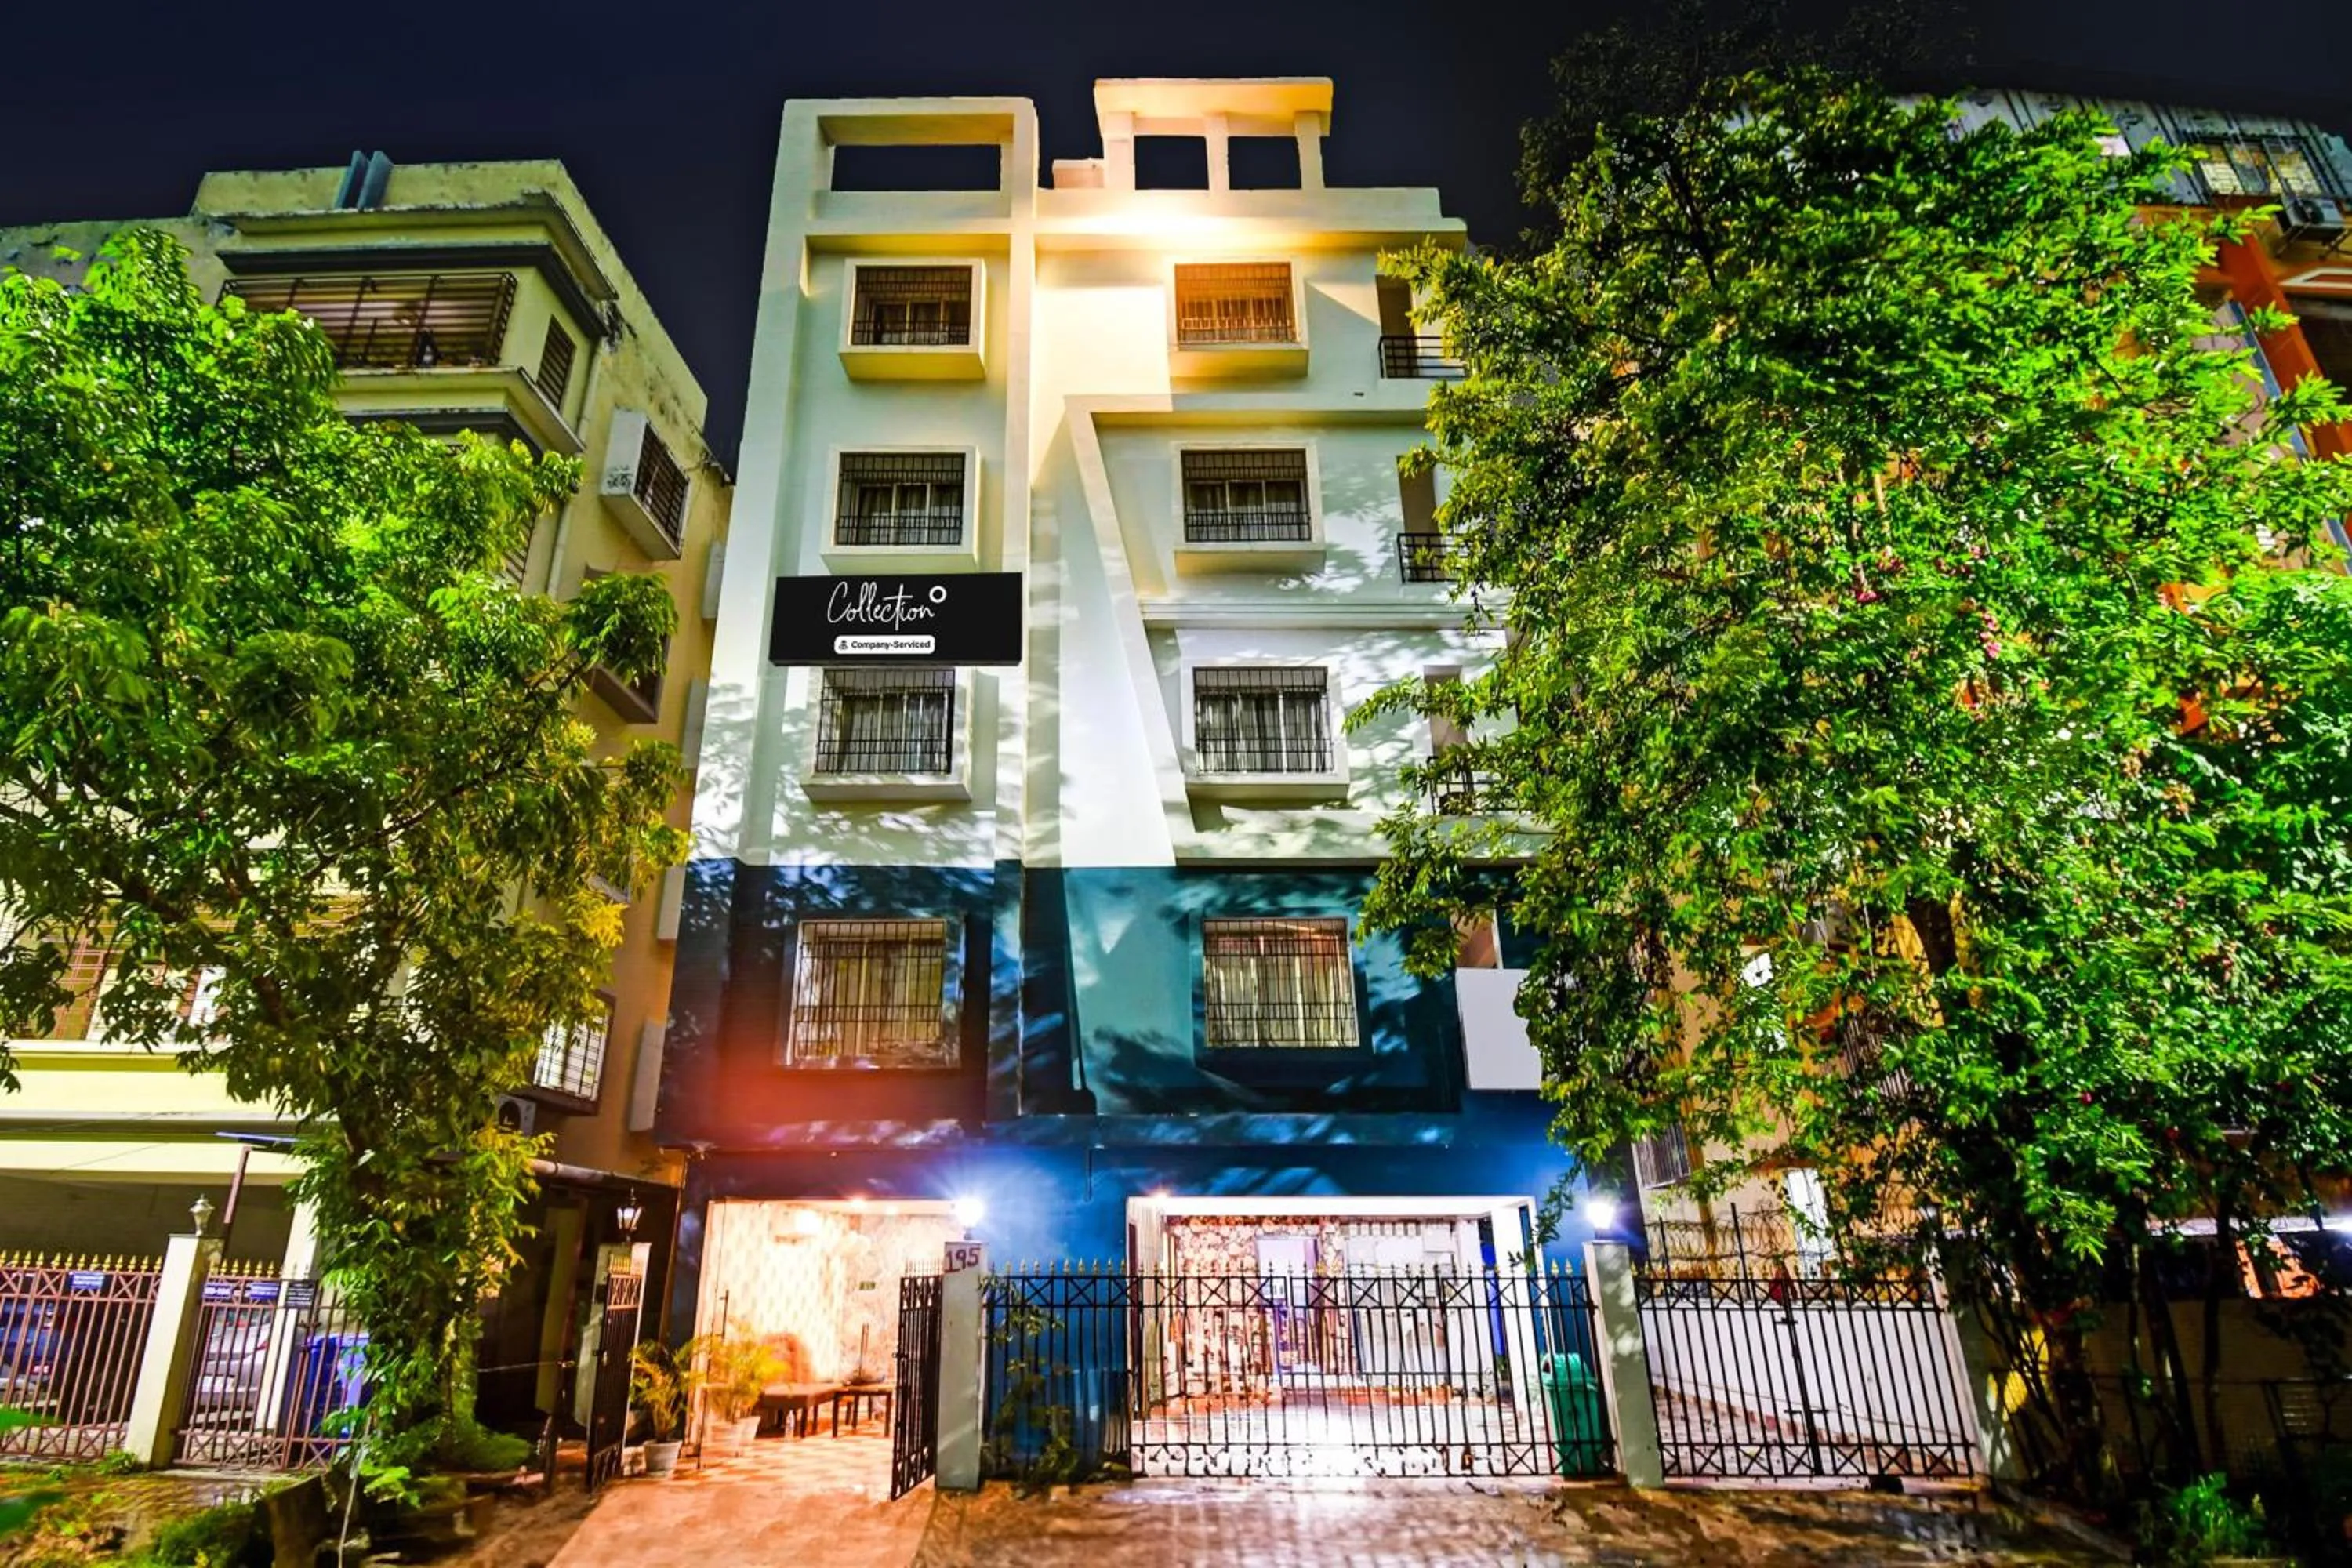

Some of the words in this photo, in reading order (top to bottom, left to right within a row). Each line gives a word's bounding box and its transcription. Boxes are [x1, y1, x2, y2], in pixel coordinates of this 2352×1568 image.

[827, 581, 935, 631] Collection
[851, 640, 931, 651] Company-Serviced
[943, 1247, 981, 1273] 195
